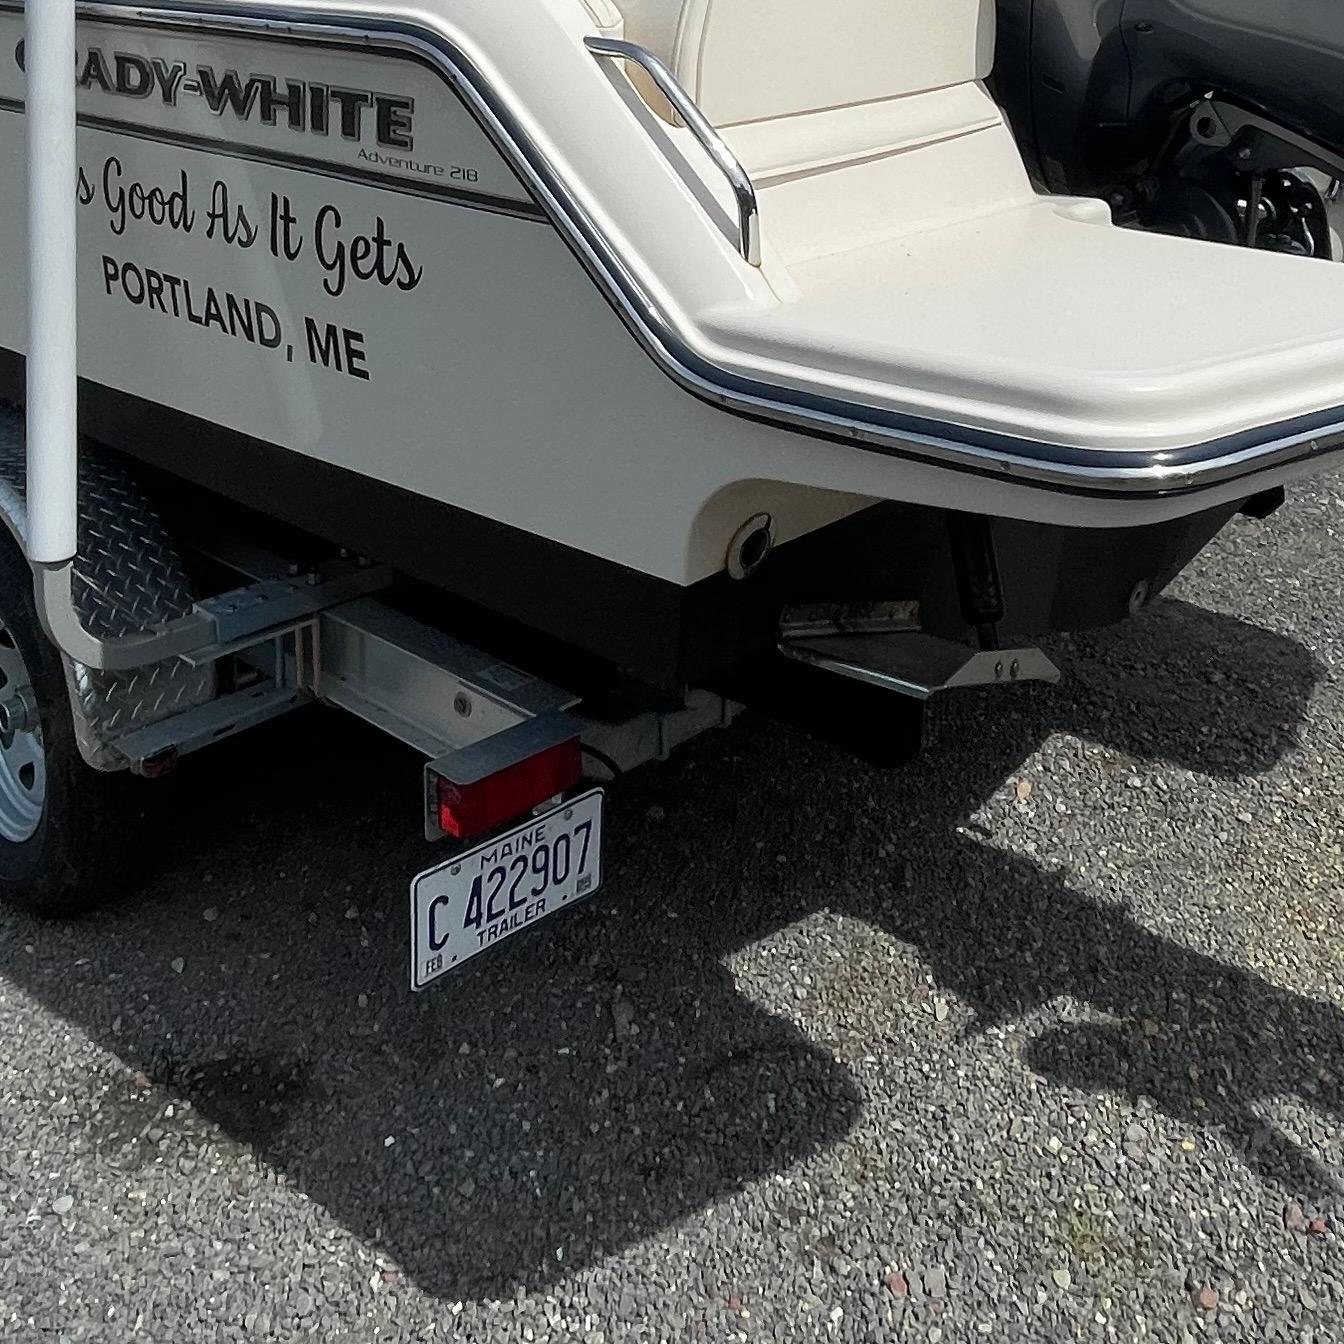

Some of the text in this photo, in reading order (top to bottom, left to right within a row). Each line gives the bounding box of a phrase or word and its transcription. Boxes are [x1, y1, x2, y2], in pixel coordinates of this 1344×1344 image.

[14, 37, 416, 152] ADY-WHITE
[357, 148, 479, 183] Adventure 218
[76, 156, 425, 297] s Good As It Gets
[102, 254, 372, 382] PORTLAND, ME
[428, 819, 593, 952] C 422907
[479, 823, 547, 870] MAINE
[476, 898, 547, 947] TRAILER
[424, 953, 443, 978] FEB
